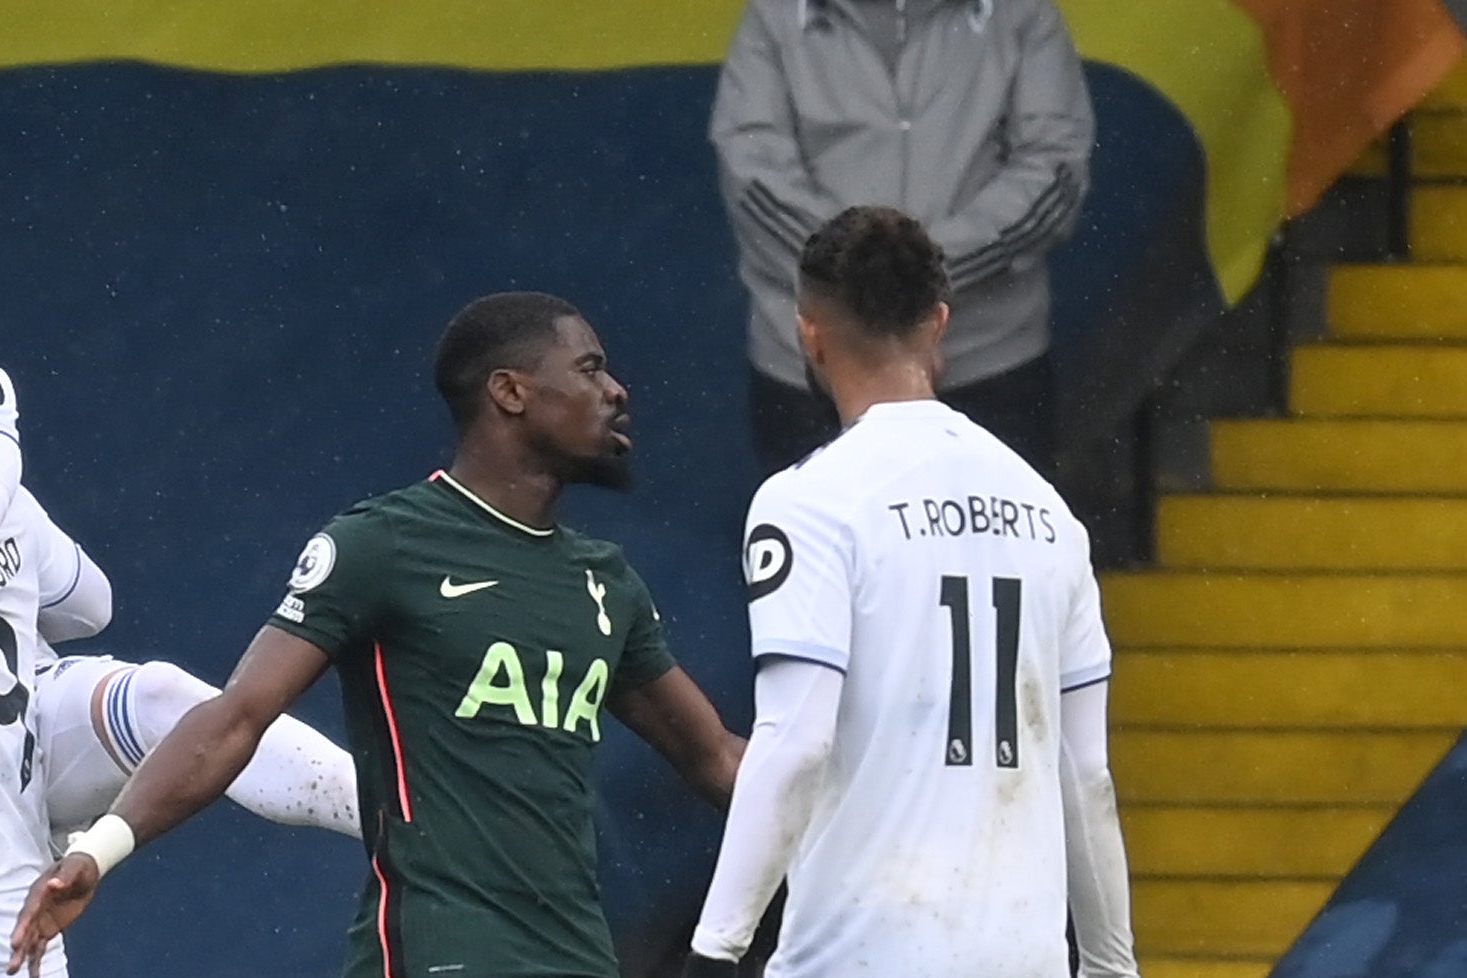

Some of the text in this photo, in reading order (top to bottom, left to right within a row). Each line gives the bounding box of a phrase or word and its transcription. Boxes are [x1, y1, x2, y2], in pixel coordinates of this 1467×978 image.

[888, 496, 1056, 544] T.ROBERTS
[454, 641, 608, 742] AIA
[940, 575, 1021, 768] 11
